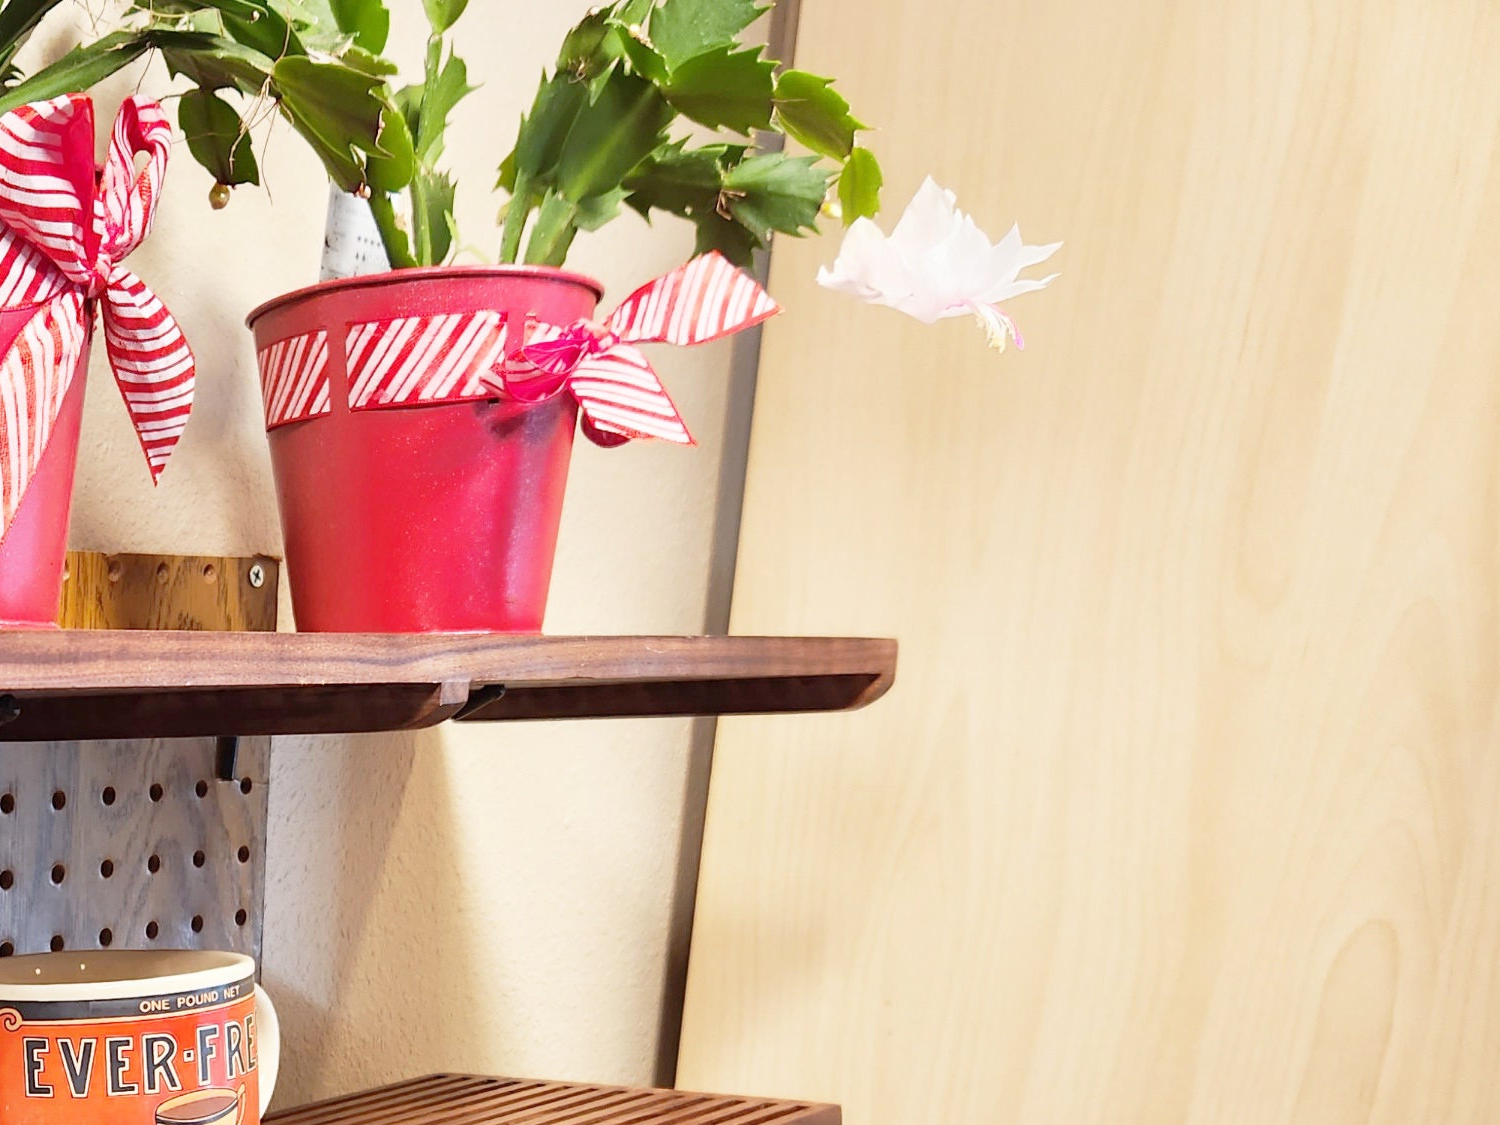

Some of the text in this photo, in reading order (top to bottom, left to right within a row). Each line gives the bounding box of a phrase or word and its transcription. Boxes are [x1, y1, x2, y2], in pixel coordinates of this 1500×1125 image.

[139, 985, 240, 1013] ONE POUND NET
